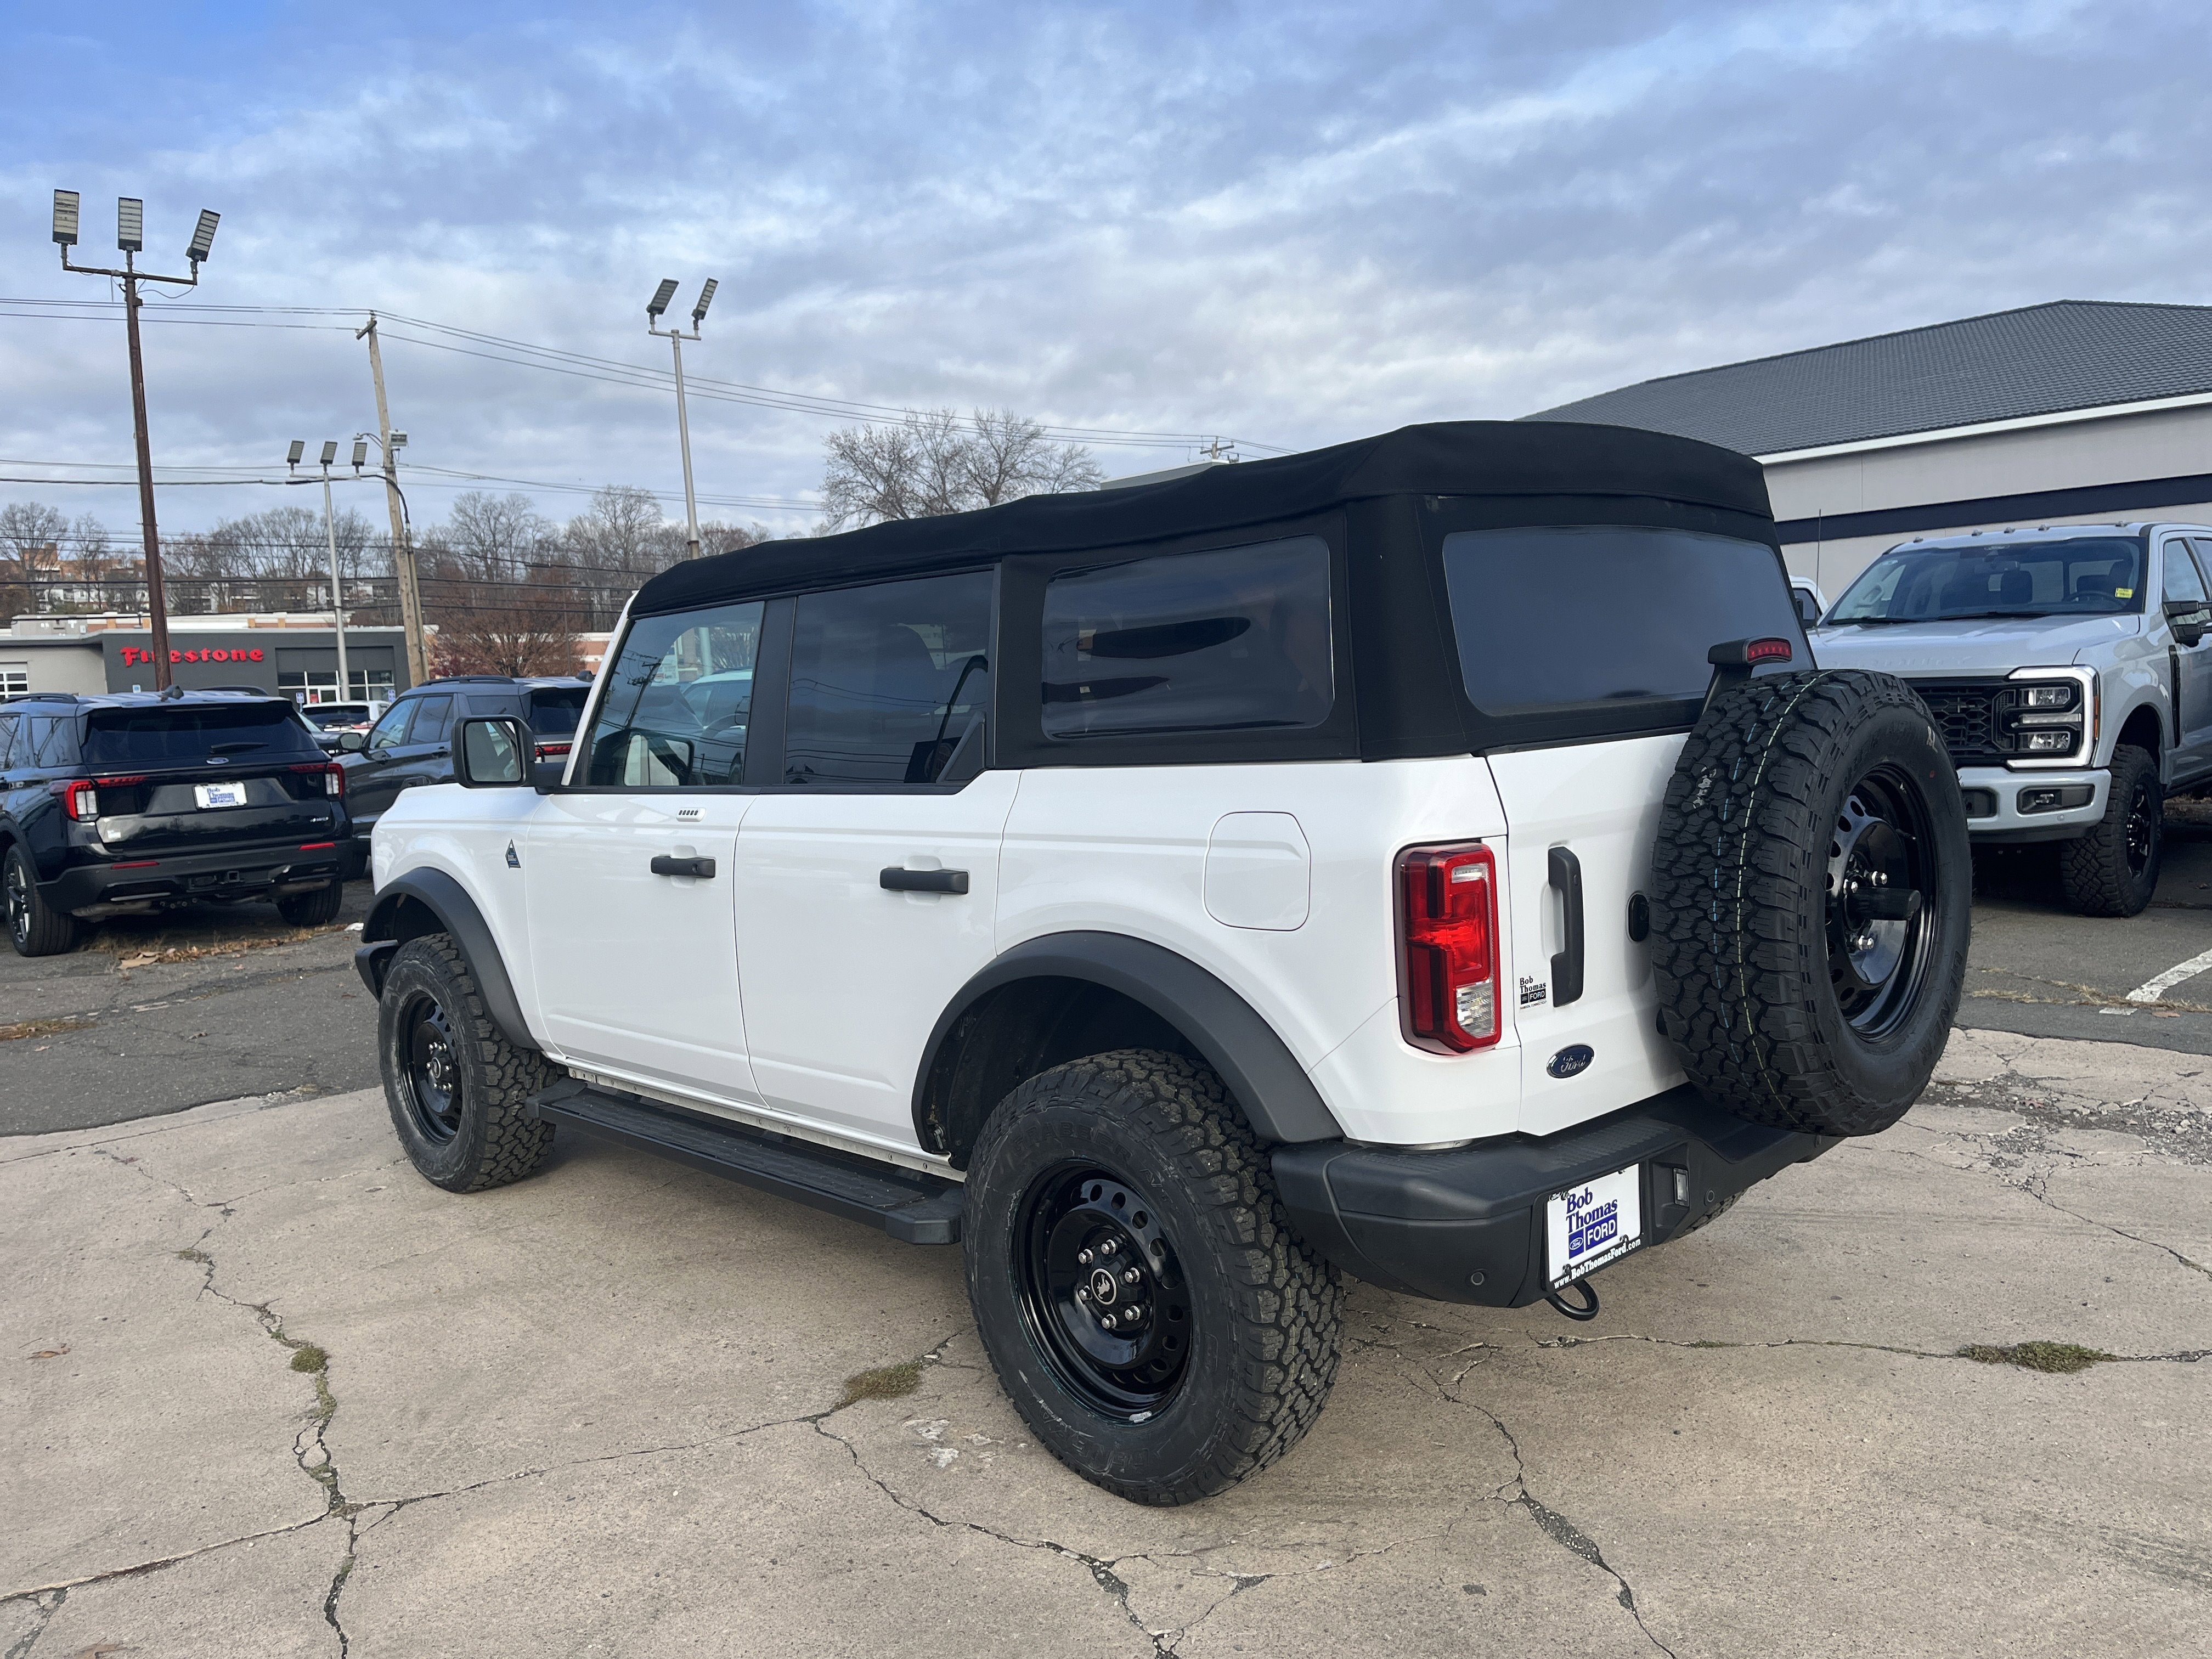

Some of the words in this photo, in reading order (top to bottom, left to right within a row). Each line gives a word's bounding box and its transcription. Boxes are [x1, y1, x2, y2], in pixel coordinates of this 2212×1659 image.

[1520, 975, 1533, 985] Bob
[1520, 982, 1547, 994] Thomas
[1530, 991, 1545, 1000] FORD
[1566, 1187, 1593, 1214] Bob
[1566, 1199, 1618, 1234] Thomas
[1587, 1219, 1616, 1245] FORD
[1554, 1238, 1641, 1289] www.BobThomasFord.com
